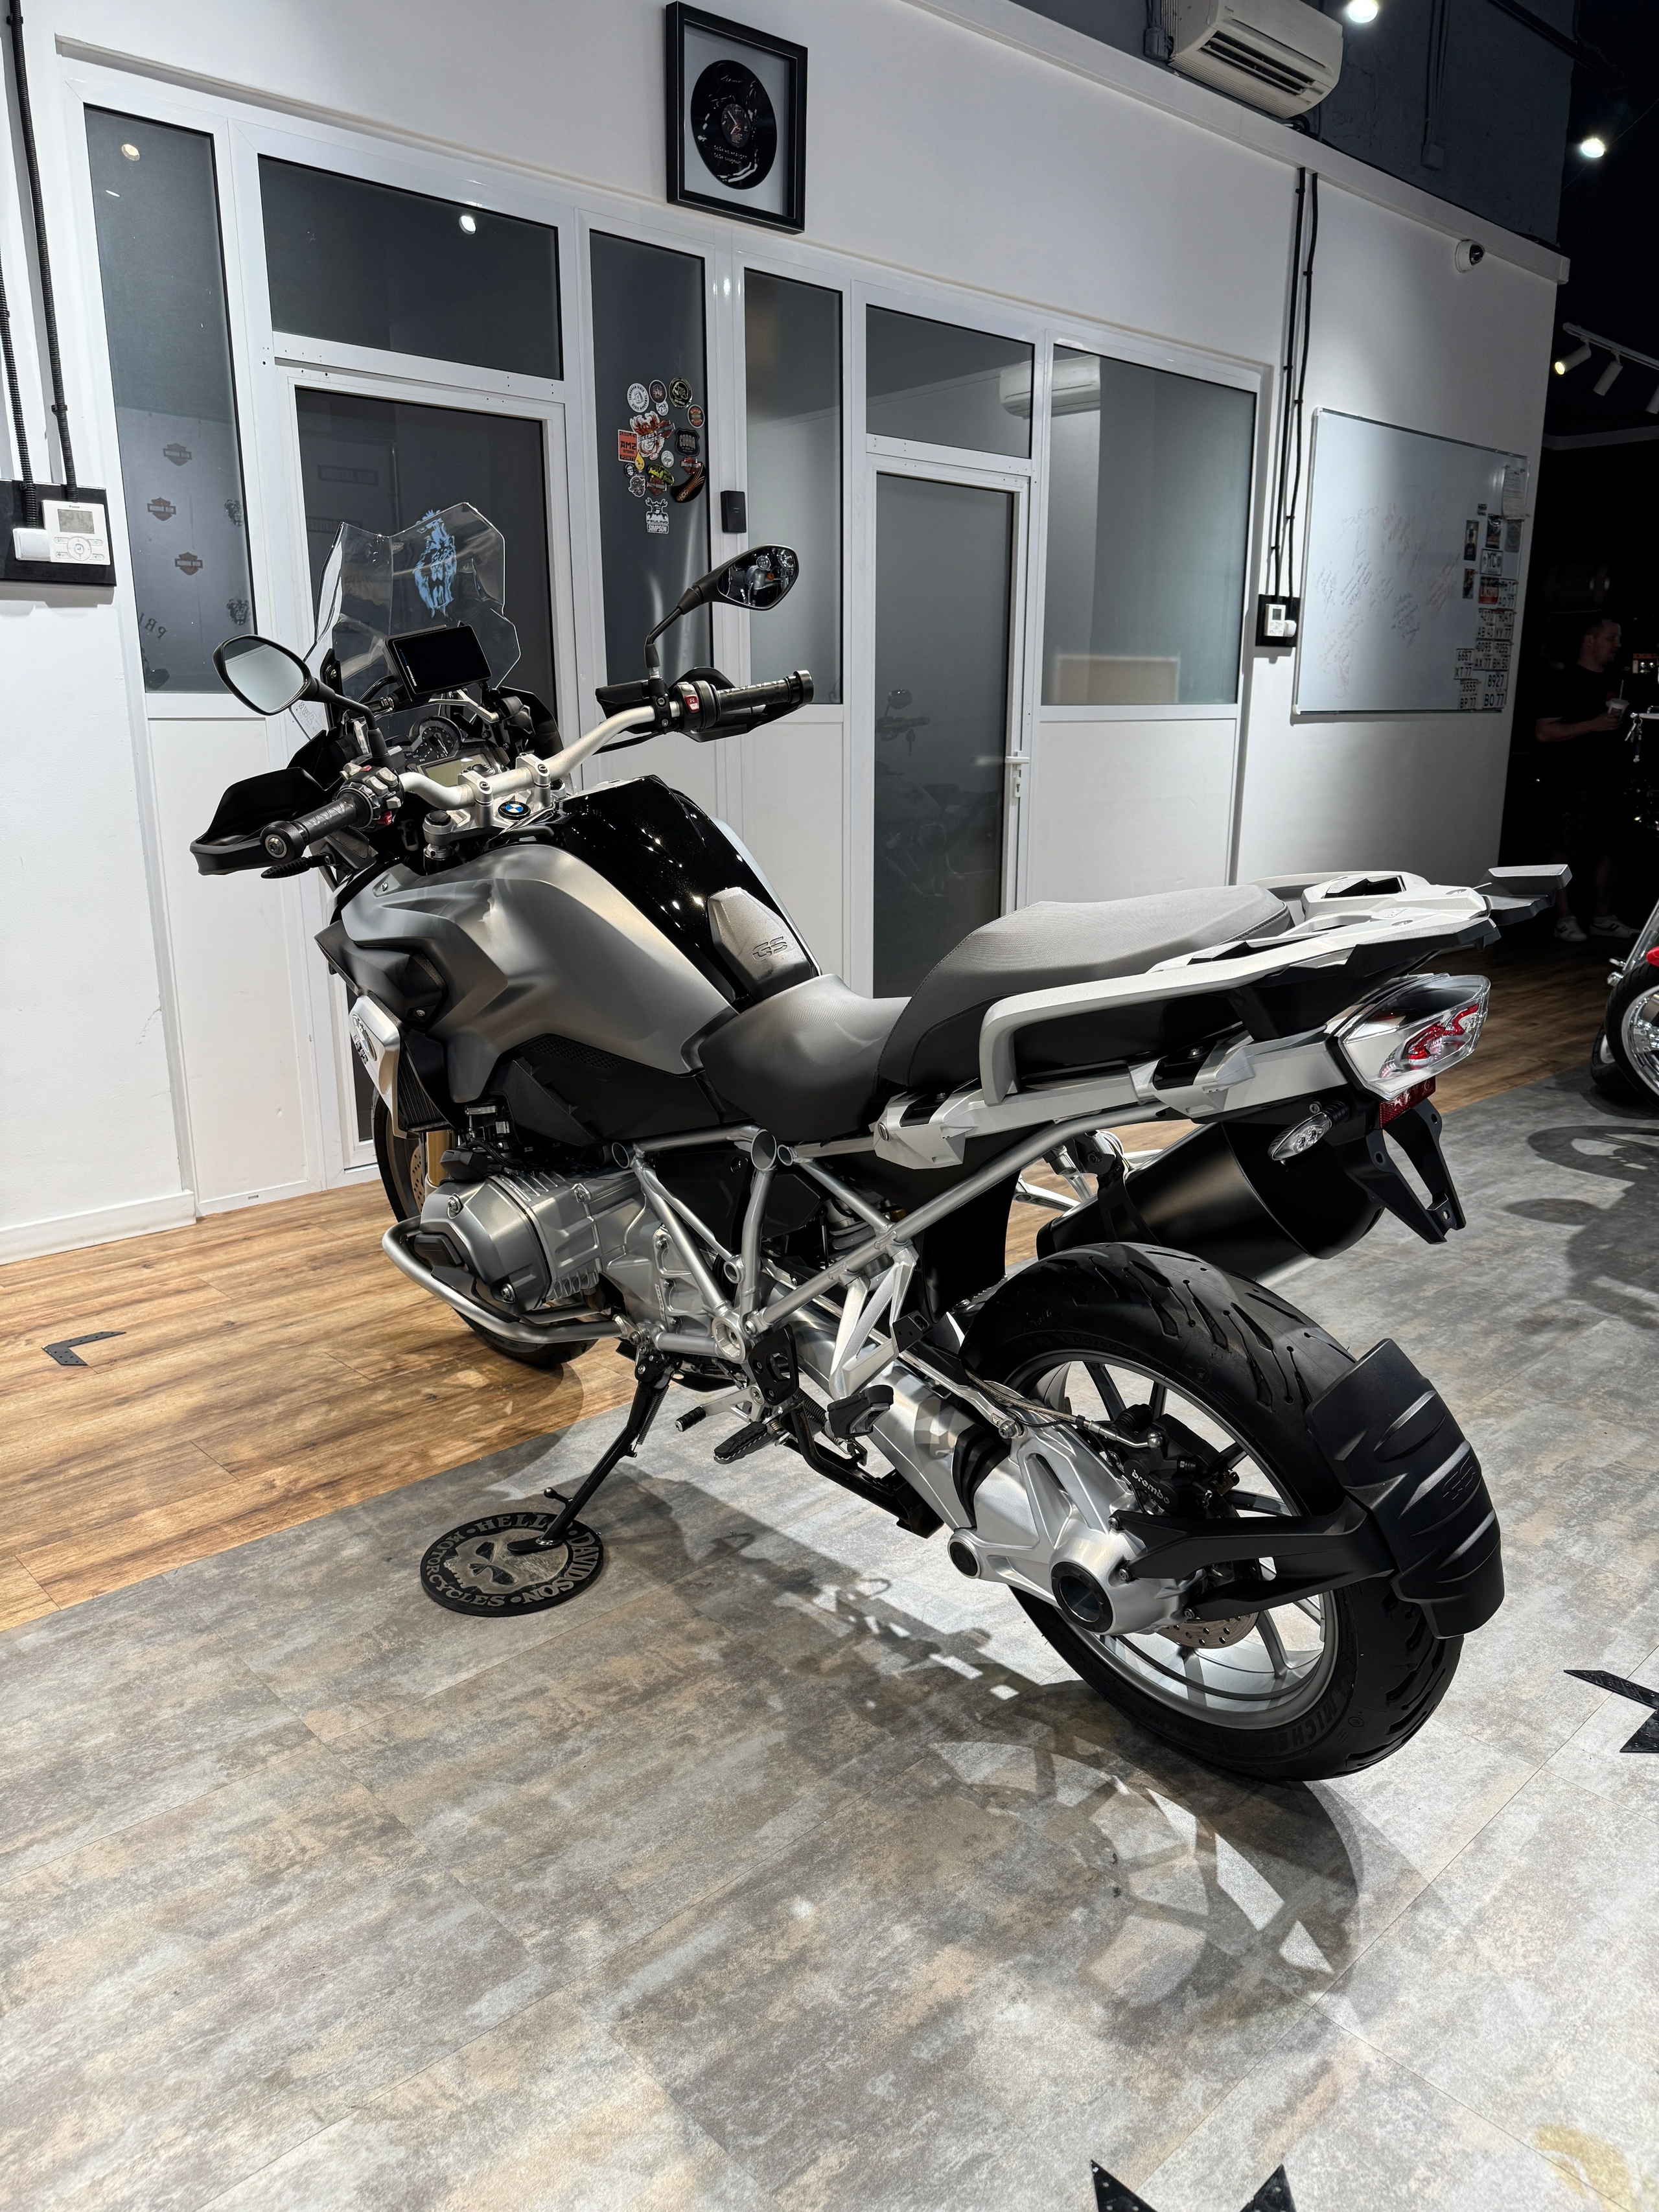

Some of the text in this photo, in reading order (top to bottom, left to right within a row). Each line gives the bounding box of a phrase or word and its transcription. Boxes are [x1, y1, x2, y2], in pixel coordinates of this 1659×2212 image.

[679, 434, 695, 449] COBRA
[1484, 658, 1491, 668] 77
[1465, 667, 1472, 677] 77
[1488, 674, 1504, 687] 8927
[1470, 697, 1476, 708] 77
[1484, 693, 1504, 706] BO 77
[752, 936, 788, 962] GS
[1443, 1456, 1476, 1502] GS
[1131, 1469, 1170, 1505] brembo
[522, 1531, 599, 1604] DAVIDSON
